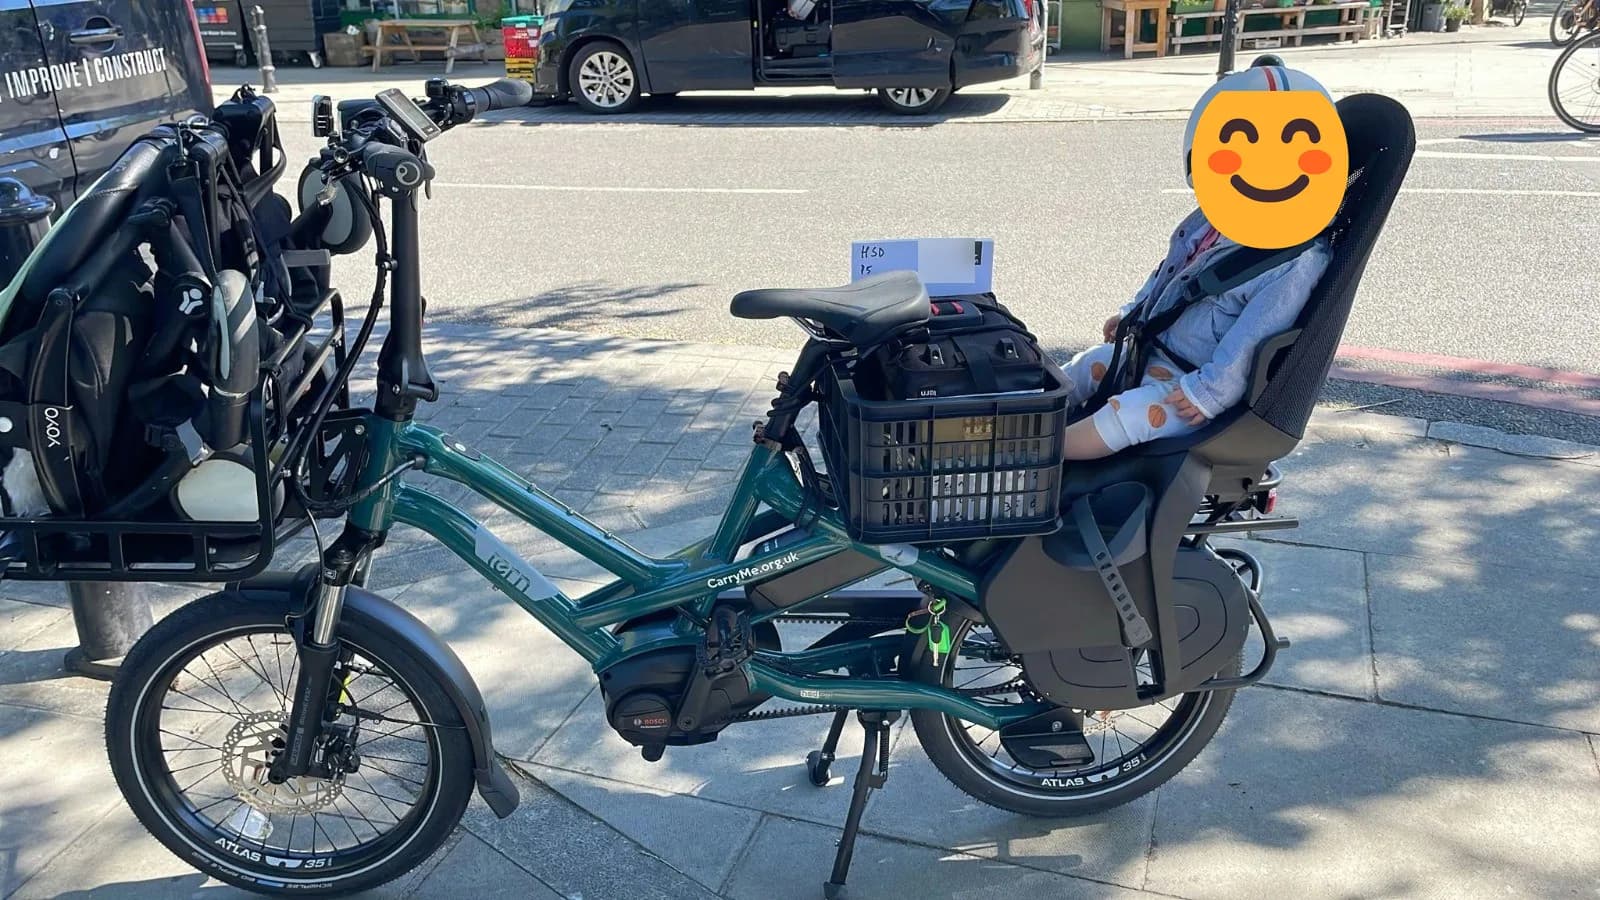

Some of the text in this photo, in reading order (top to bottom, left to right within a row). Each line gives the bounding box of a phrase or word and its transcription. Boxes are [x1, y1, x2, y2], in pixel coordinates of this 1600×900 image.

[5, 61, 82, 99] IMPROVE
[94, 47, 167, 83] CONSTRUCT
[861, 245, 885, 259] HSD
[44, 407, 61, 448] YOYO
[487, 551, 531, 593] tern
[707, 551, 800, 588] CarryMe.org.uk
[1041, 778, 1085, 787] ATLAS
[214, 837, 262, 862] ATLAS
